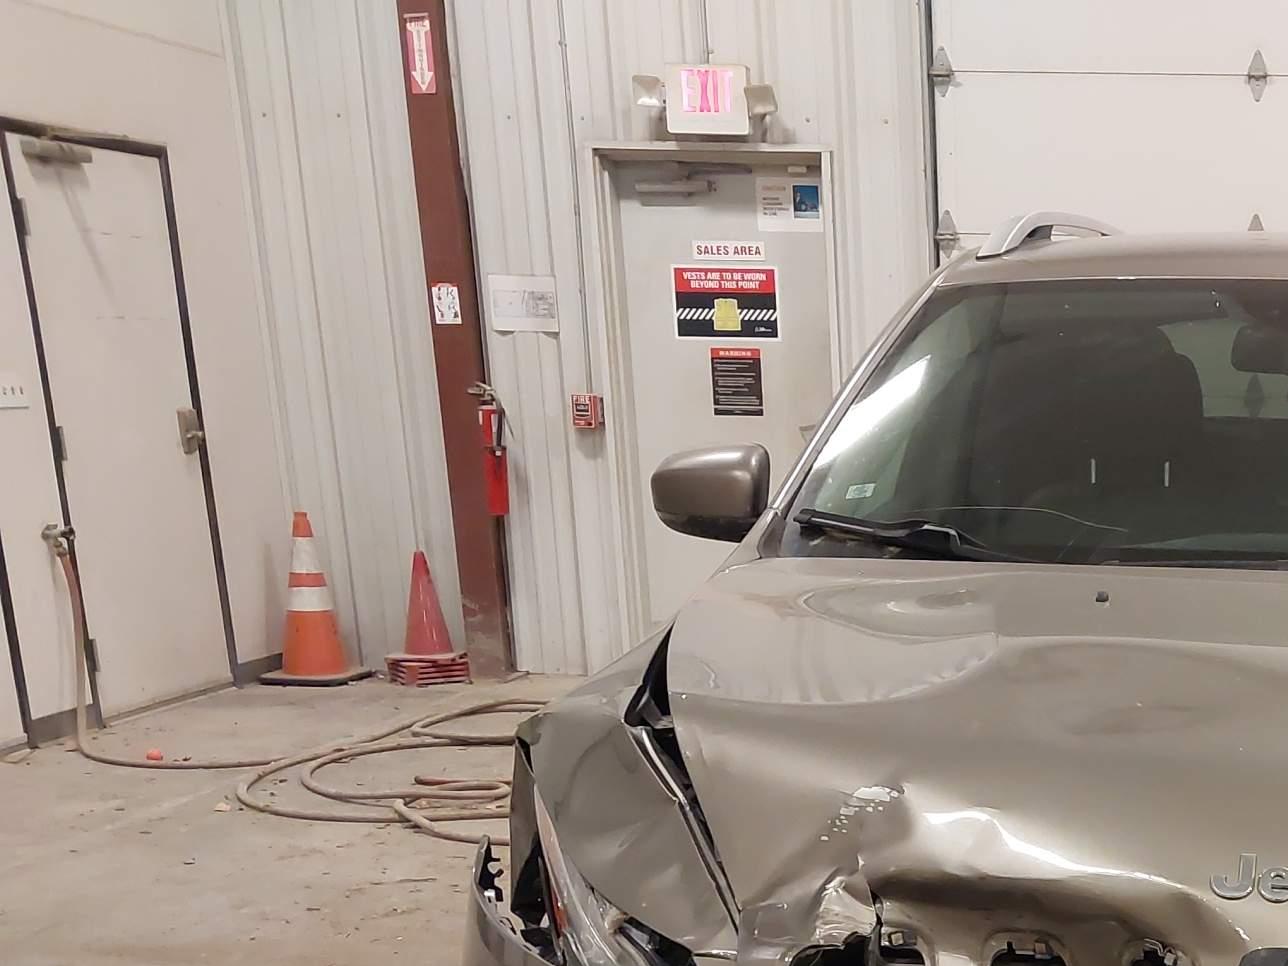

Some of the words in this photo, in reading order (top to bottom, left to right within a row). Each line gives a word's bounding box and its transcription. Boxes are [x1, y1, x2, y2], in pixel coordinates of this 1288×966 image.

[680, 69, 734, 113] EXIT
[696, 245, 730, 256] SALES
[733, 245, 762, 256] AREA
[682, 272, 706, 280] VESTS
[706, 272, 721, 280] ARE
[722, 272, 732, 280] TO
[743, 273, 766, 281] WORN
[690, 280, 720, 289] BEYOND
[720, 280, 737, 289] THIS
[738, 281, 760, 289] POINT
